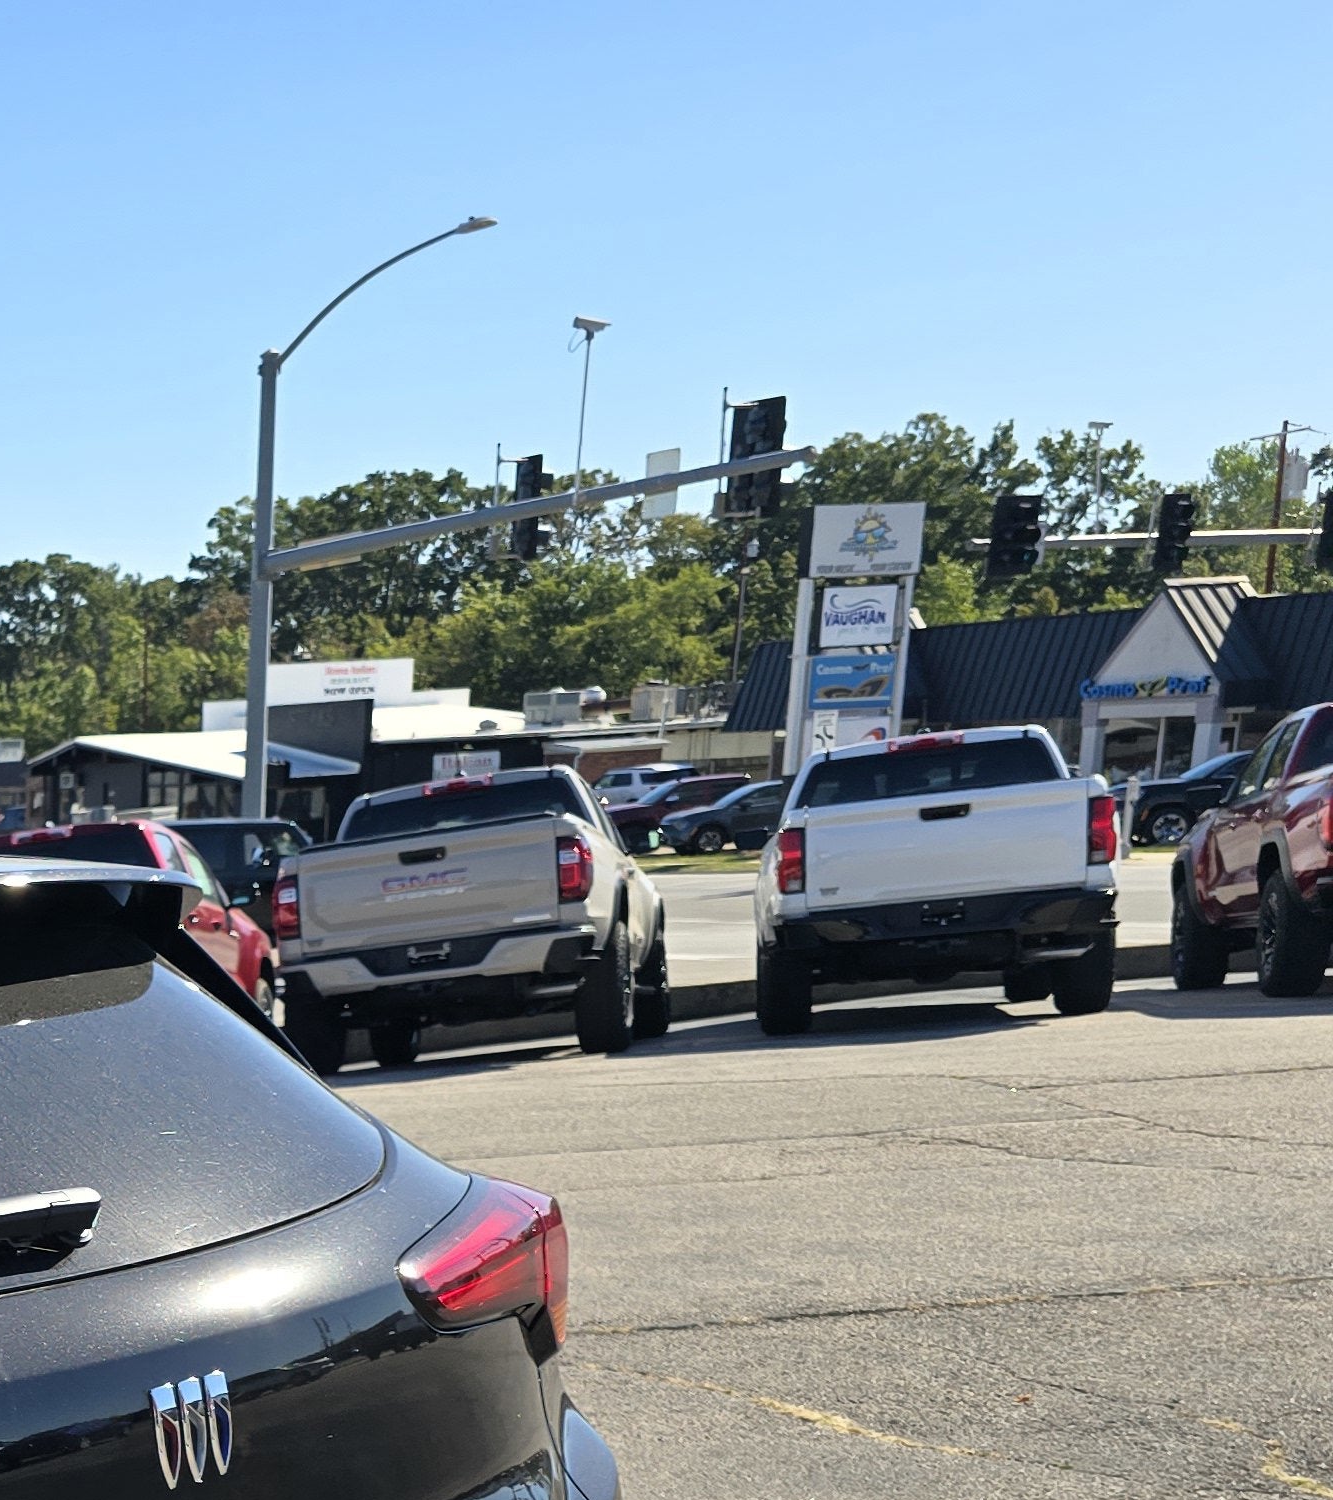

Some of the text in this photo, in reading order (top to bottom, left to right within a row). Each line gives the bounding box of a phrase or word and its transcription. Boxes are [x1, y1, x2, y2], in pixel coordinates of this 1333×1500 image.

[825, 611, 887, 627] VAUGHAN
[816, 662, 894, 676] Cosmo Prof
[324, 686, 375, 696] NOW OPEN
[1080, 676, 1212, 699] Cosmo Prof
